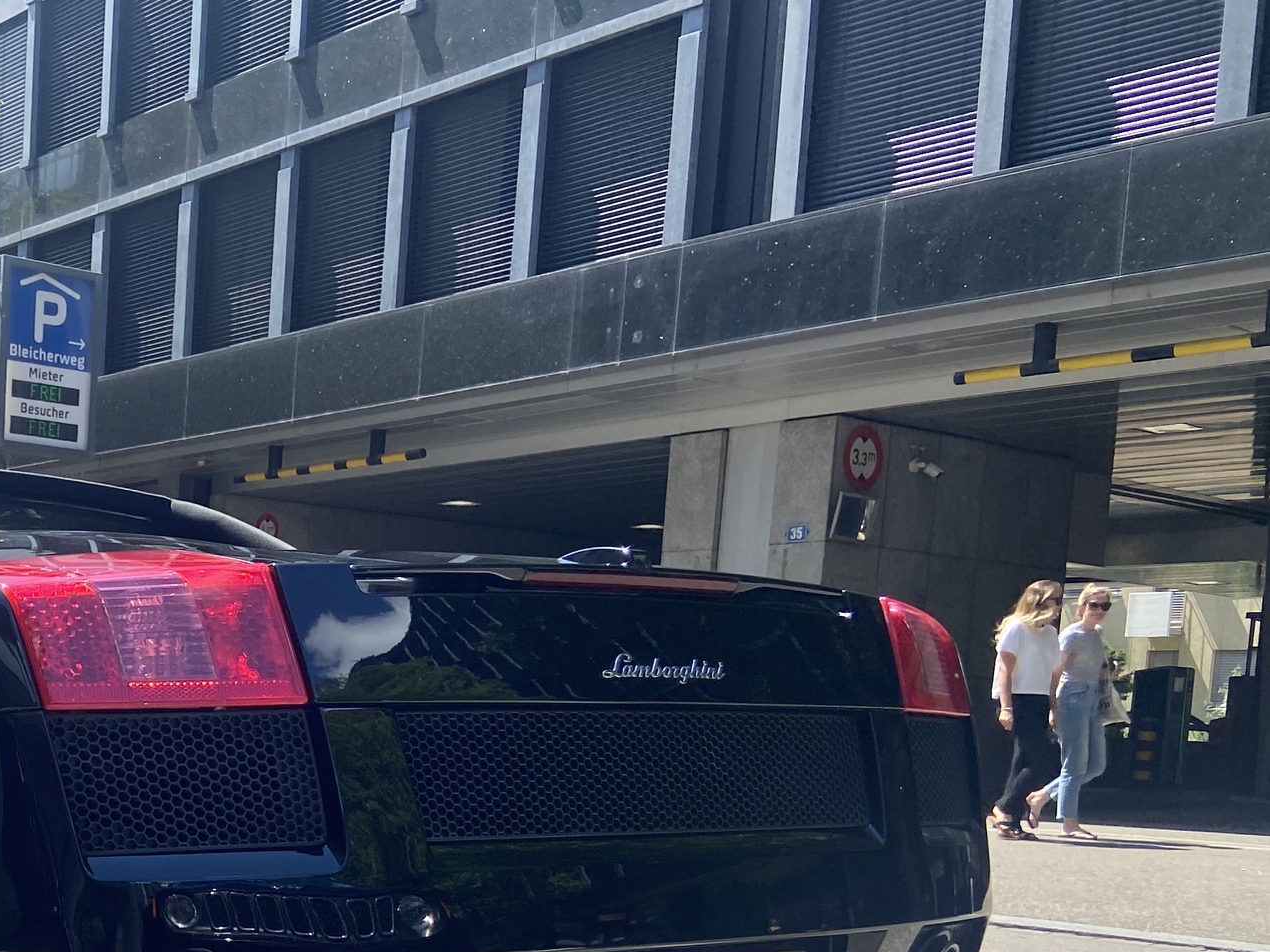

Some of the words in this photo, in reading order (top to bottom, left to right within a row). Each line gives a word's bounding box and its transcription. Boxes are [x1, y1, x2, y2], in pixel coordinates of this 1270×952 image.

[34, 290, 68, 343] P
[9, 343, 86, 371] Bleicherweg
[28, 367, 65, 383] Mieter
[30, 384, 62, 402] FREI
[20, 402, 70, 419] Besucher
[29, 421, 61, 437] FREI
[790, 526, 803, 540] 35
[602, 653, 726, 684] Lamborghini
